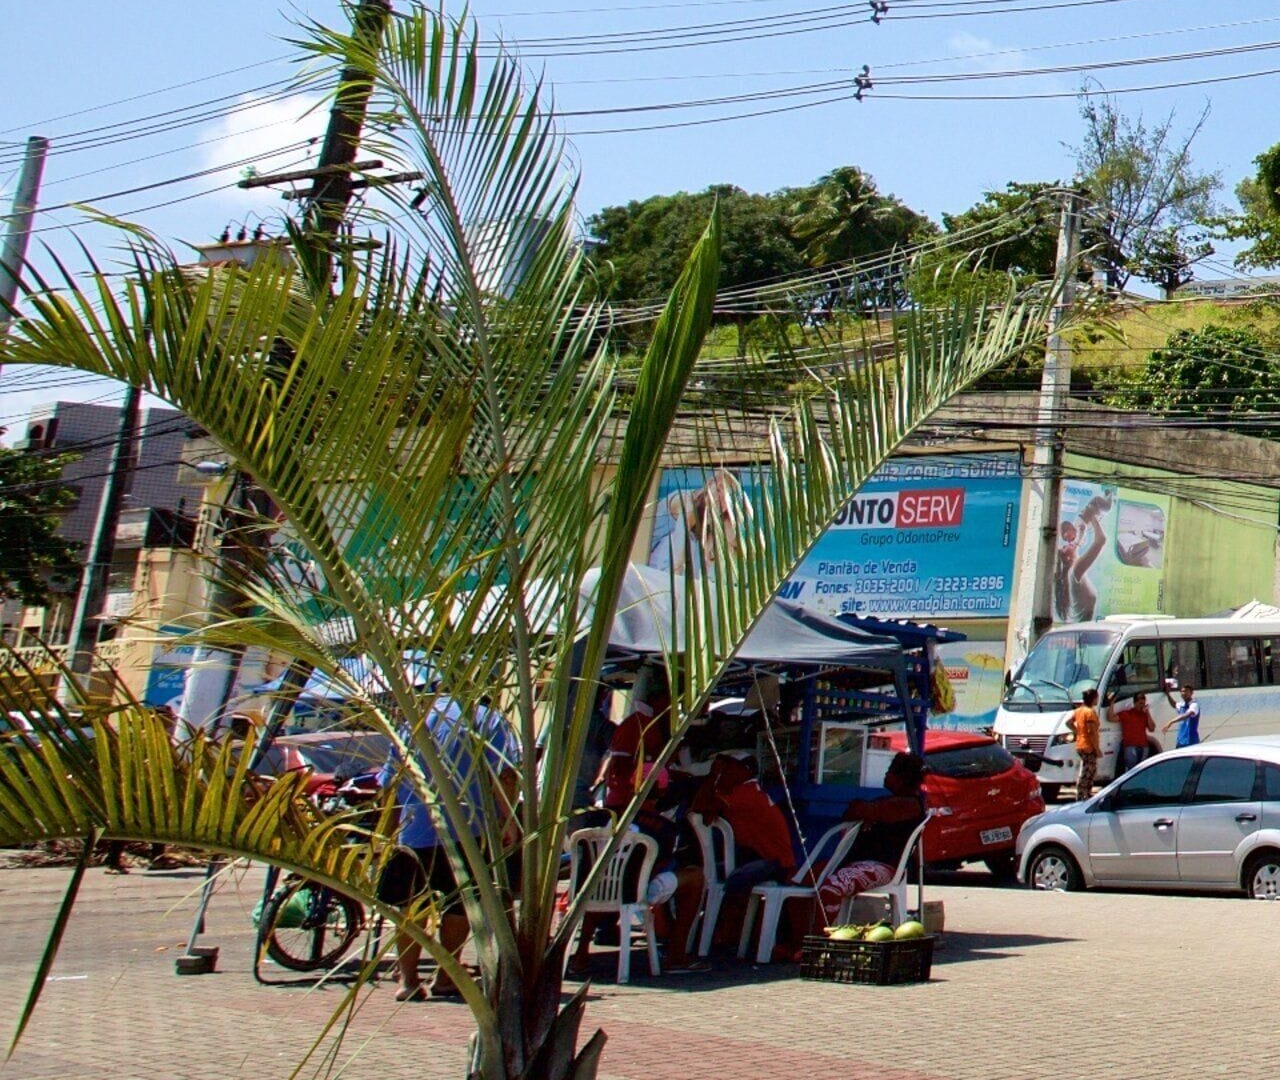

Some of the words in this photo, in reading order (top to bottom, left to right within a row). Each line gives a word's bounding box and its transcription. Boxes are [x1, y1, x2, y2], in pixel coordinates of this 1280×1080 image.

[904, 466, 938, 480] com
[960, 461, 1017, 477] sorriso
[832, 497, 895, 525] ONTO
[900, 495, 960, 524] SERV
[860, 532, 893, 547] Grupo
[896, 530, 960, 545] OdontoPrev
[818, 560, 860, 575] Plantão
[863, 561, 878, 574] de
[883, 560, 917, 573] Venda
[815, 581, 852, 594] Fones:
[854, 579, 920, 594] 3035-2001
[935, 575, 1004, 592] 3223-2896
[842, 598, 867, 612] site:
[869, 595, 1003, 615] www.vendplan.com.br
